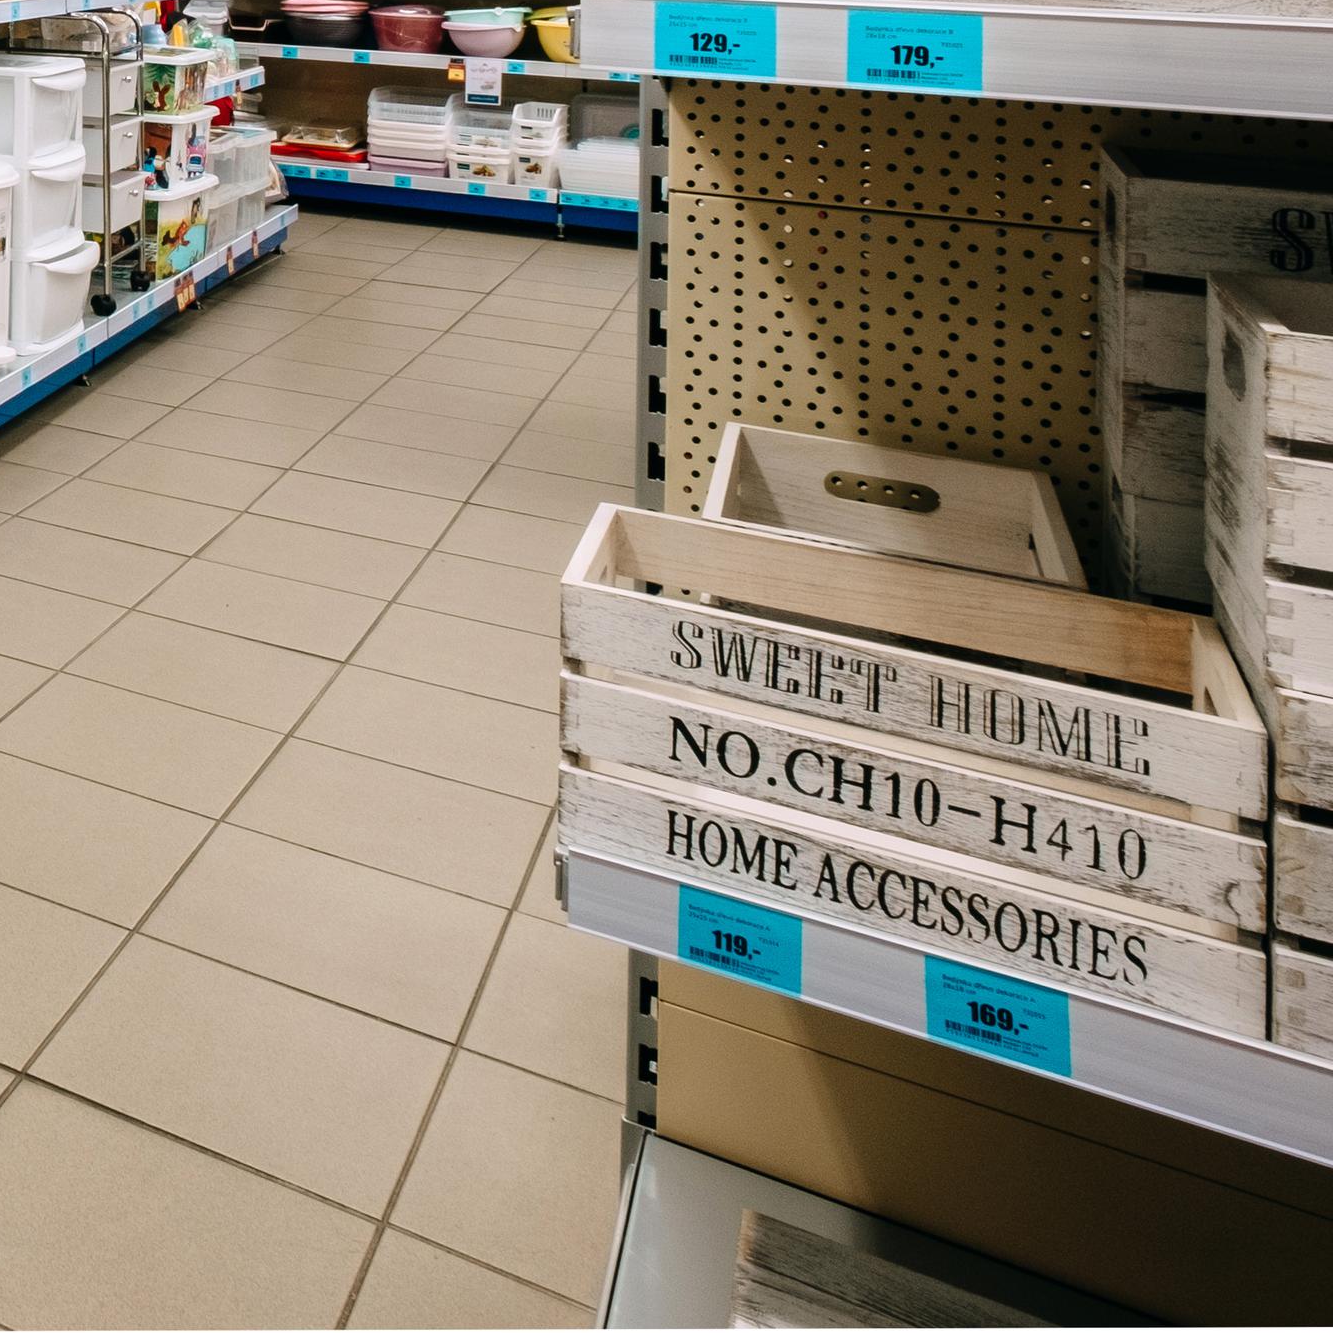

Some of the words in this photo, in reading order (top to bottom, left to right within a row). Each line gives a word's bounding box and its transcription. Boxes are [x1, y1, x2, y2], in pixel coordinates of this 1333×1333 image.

[689, 33, 741, 55] 129,-
[890, 45, 944, 69] 179,-
[670, 620, 897, 714] SWEET
[930, 674, 1151, 777] HOME
[666, 810, 799, 893] HOME
[815, 854, 1148, 986] ACCESSORIES
[711, 930, 761, 960] 119,-
[967, 1001, 1029, 1035] 169,-
